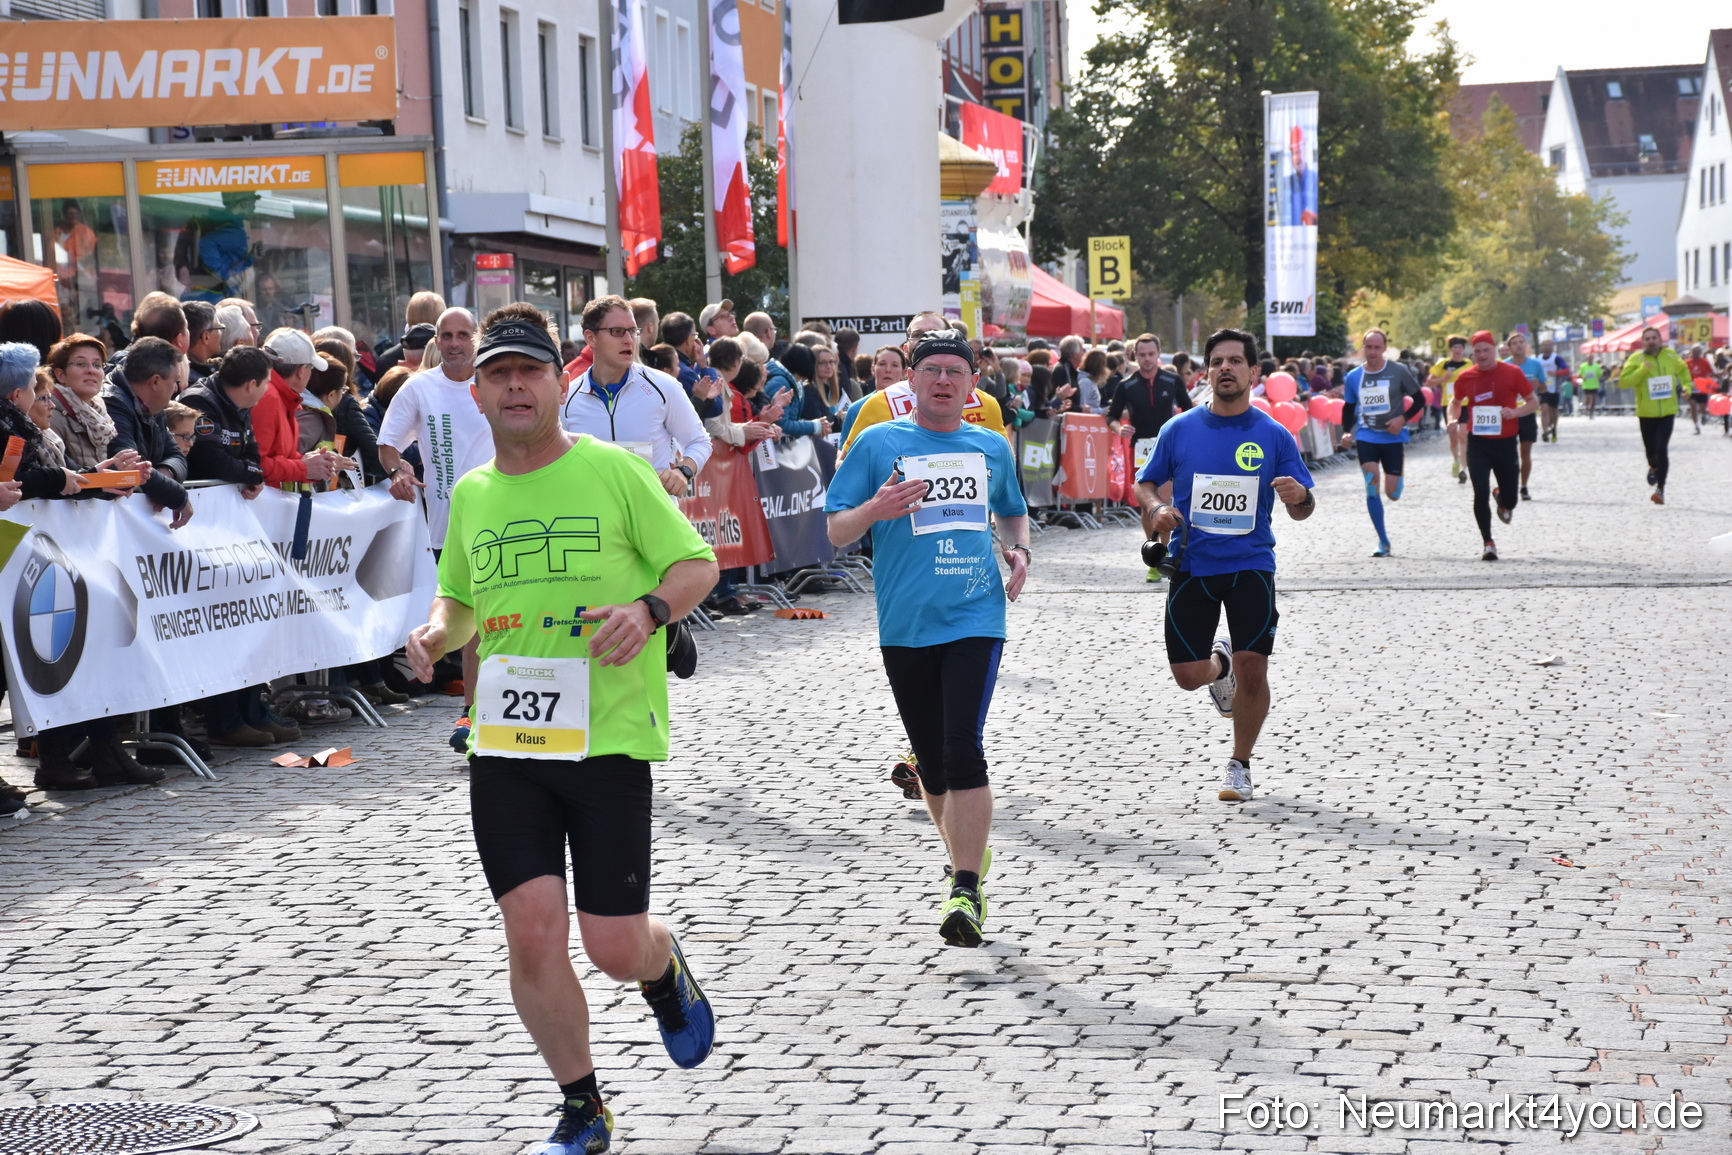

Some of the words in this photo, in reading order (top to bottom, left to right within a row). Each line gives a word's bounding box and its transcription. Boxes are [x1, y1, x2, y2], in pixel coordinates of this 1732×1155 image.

[0, 47, 375, 102] UNMARKT.DE
[156, 164, 311, 188] RUNMARKT.DE
[1093, 240, 1125, 251] Block
[1100, 256, 1120, 285] B
[1269, 301, 1303, 314] swn
[1364, 395, 1385, 404] 2208
[1476, 415, 1497, 424] 2018
[922, 476, 978, 503] 2323
[760, 489, 812, 520] RAIL.ONE
[1200, 492, 1248, 512] 2003
[943, 508, 964, 518] Klaus
[1213, 516, 1232, 524] Saeid
[719, 508, 741, 544] Hits
[936, 538, 958, 554] 18.
[935, 556, 980, 564] Neumarkter
[136, 550, 193, 600] BMW
[934, 565, 974, 576] Stadtlauf
[503, 575, 579, 588] Automatisierungstechnik
[580, 575, 601, 583] GmbH
[151, 607, 204, 642] WENIGER
[517, 667, 555, 677] BOCK
[502, 689, 560, 722] 237
[516, 732, 546, 745] Klaus
